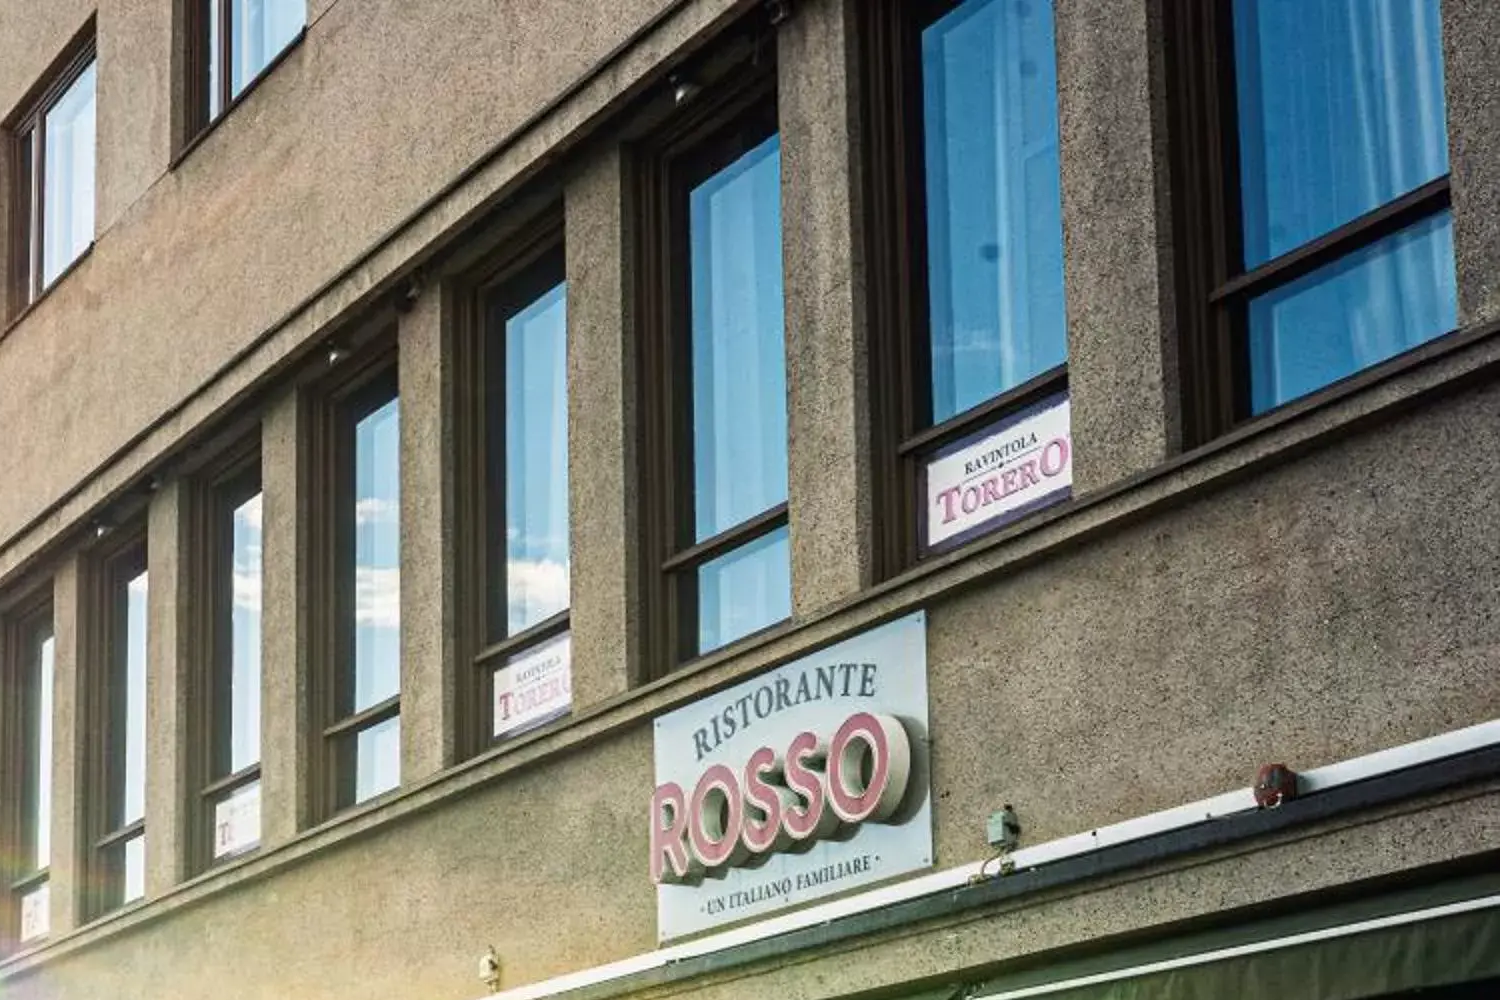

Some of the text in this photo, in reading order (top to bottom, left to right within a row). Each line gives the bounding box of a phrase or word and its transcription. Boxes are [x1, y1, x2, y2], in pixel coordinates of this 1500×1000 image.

[937, 437, 1069, 525] TORERO
[964, 432, 1038, 475] RAVINTOLA
[692, 663, 878, 762] RISTORANTE
[650, 711, 891, 882] ROSSO
[706, 855, 872, 915] UN ITALIANO FAMILIARE
